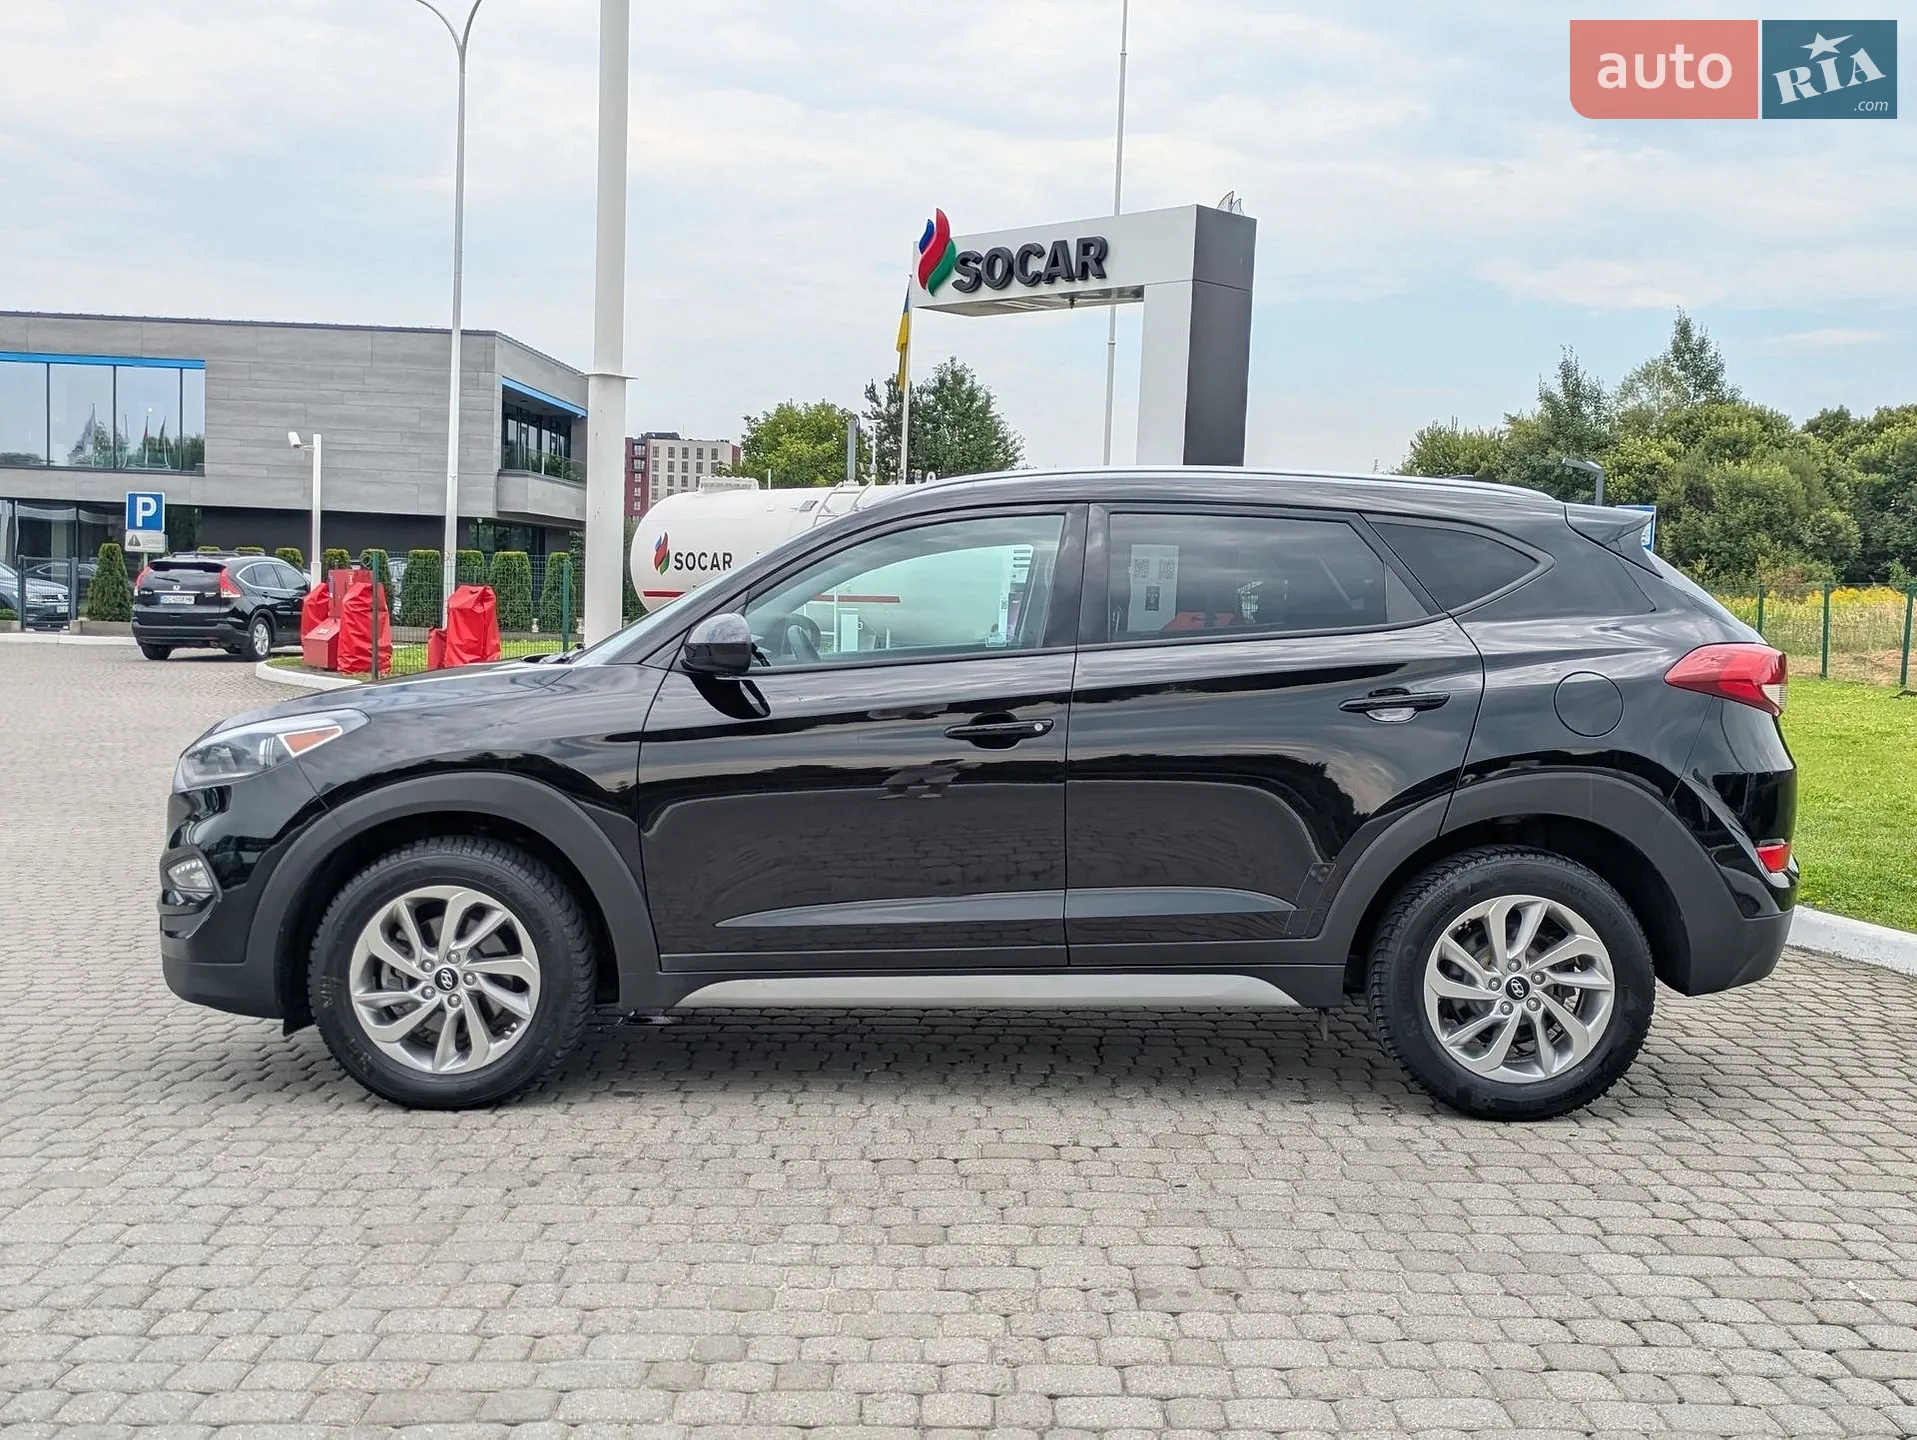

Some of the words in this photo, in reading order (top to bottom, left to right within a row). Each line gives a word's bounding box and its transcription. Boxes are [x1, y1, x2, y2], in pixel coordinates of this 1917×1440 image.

[952, 235, 1108, 293] SOCAR
[136, 496, 157, 527] P
[674, 551, 733, 571] SOCAR
